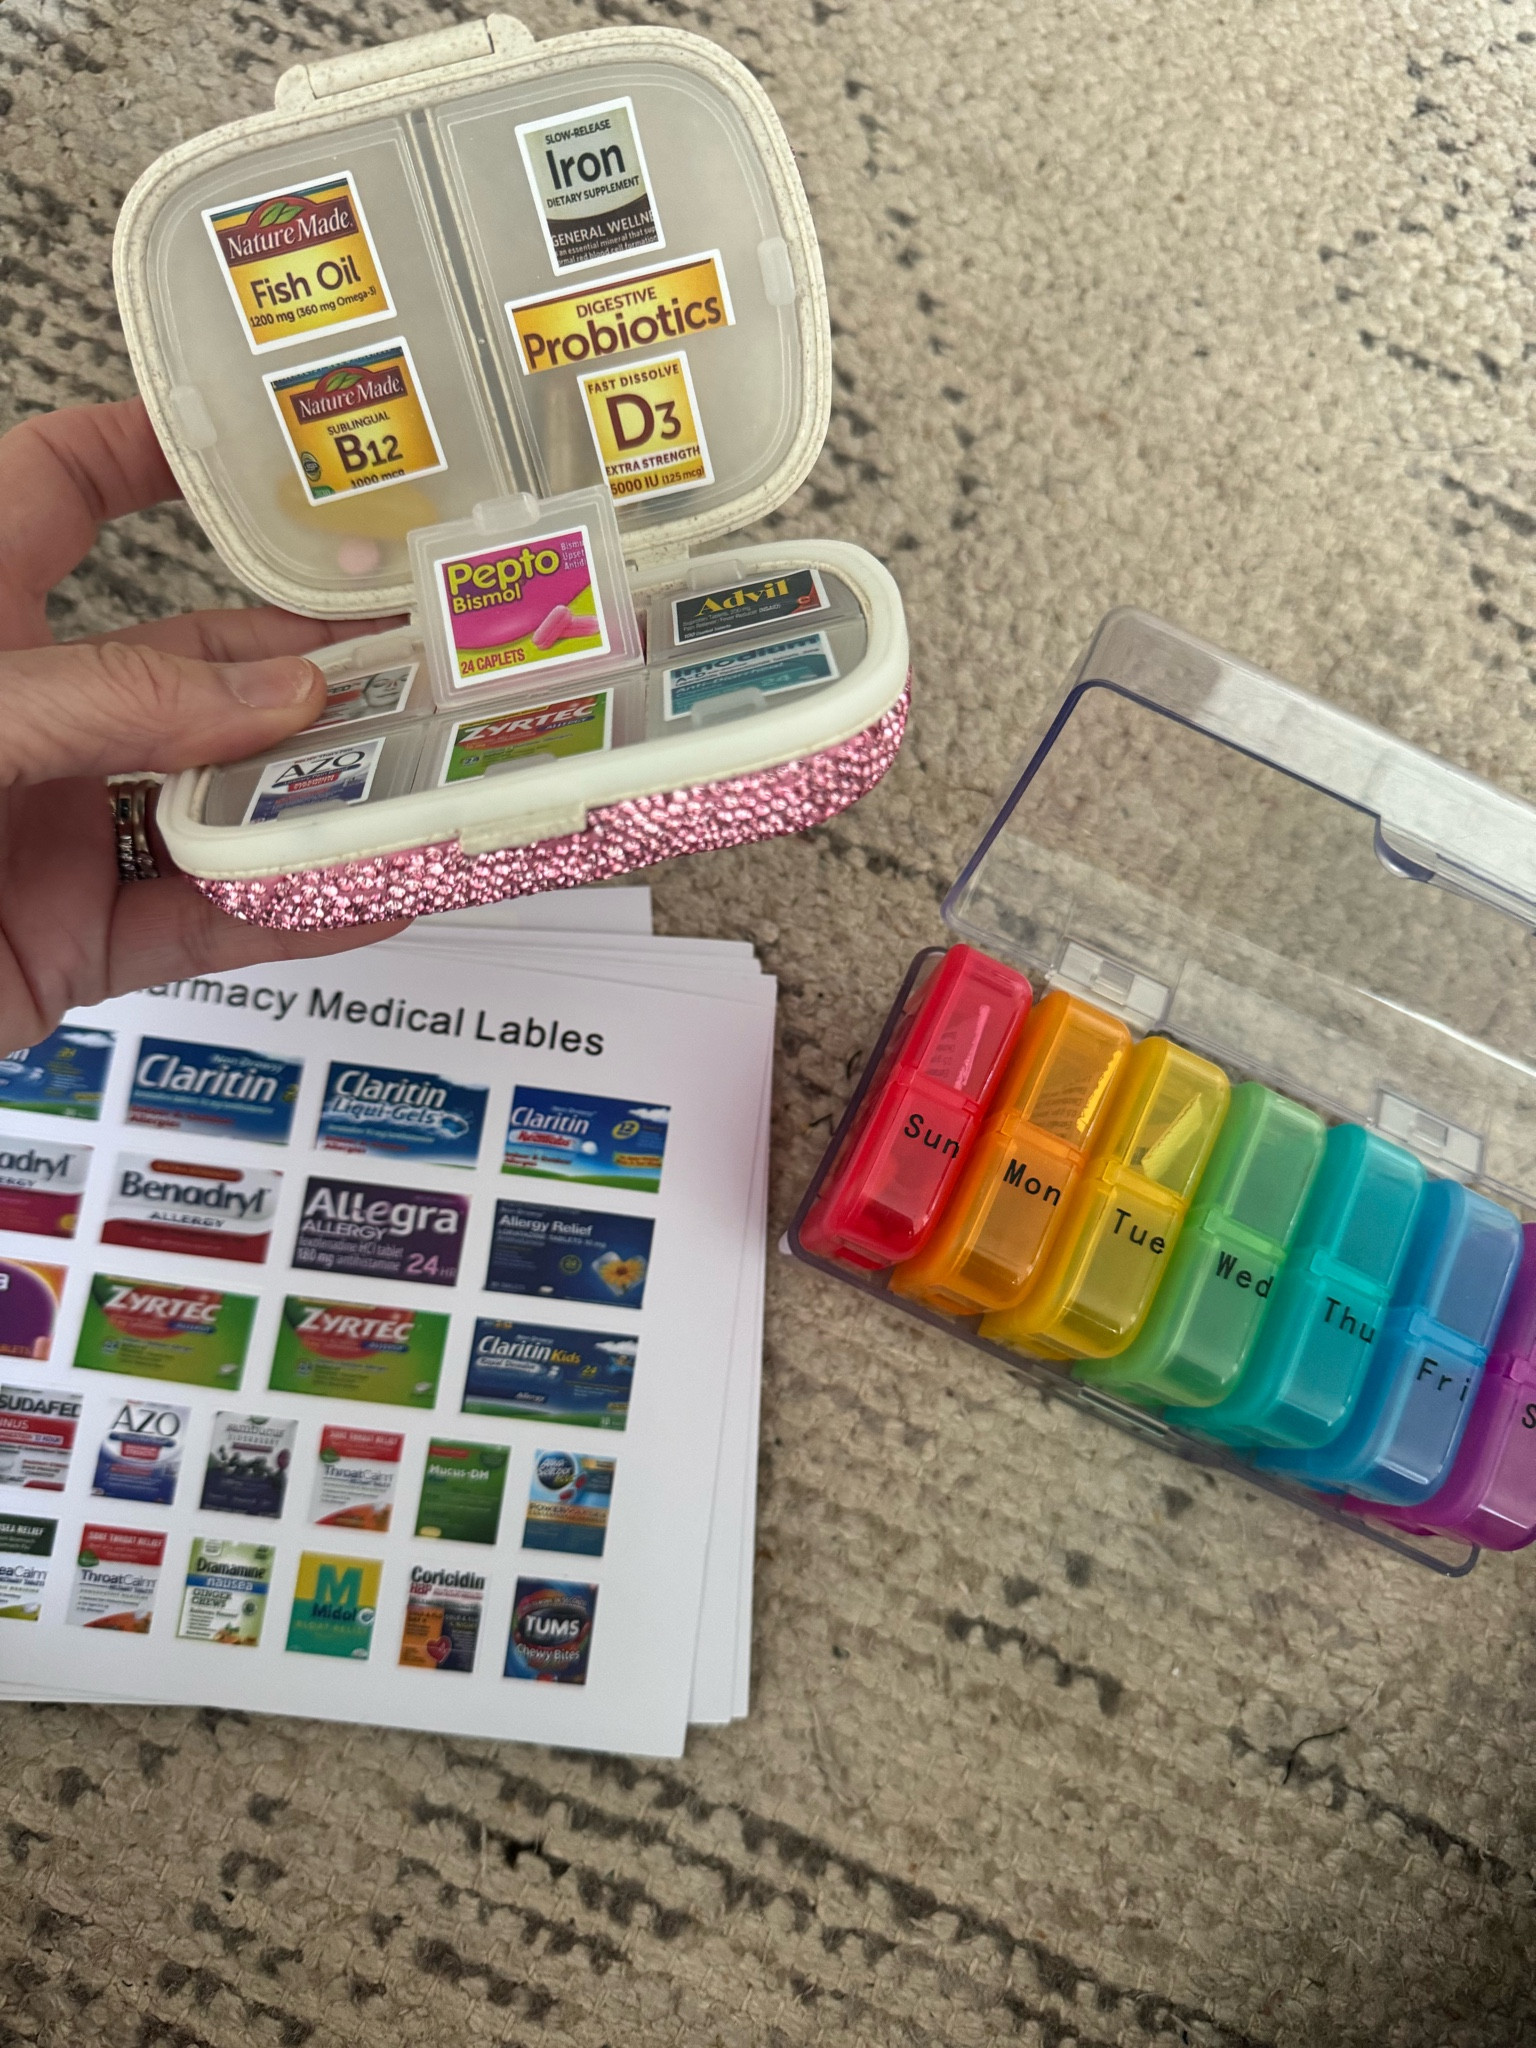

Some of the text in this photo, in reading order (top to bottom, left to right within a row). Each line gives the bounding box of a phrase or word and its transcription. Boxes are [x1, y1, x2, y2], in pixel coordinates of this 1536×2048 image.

[545, 119, 611, 145] SLOW-RELEASE
[545, 144, 626, 190] Iron
[546, 175, 640, 209] DIETARY SUPPLEMENT
[227, 207, 351, 259] Nature Made
[552, 224, 606, 247] GENERAL
[250, 255, 361, 309] Fish Oil
[250, 286, 376, 328] 1200 mg (360 mg Omega-3)
[576, 286, 658, 318] DIGESTIVE
[522, 296, 722, 369] Probiotics
[587, 363, 680, 395] FAST DISSOLVE
[299, 391, 355, 419] Nature
[606, 393, 681, 451] D3
[327, 410, 390, 436] SUBLINGUAL
[333, 434, 404, 474] B12
[605, 446, 701, 476] EXTRA STRENGTH
[351, 473, 379, 489] 1000
[610, 478, 642, 495] 5000
[644, 474, 659, 489] IU
[447, 548, 560, 596] Pepto
[452, 583, 521, 614] Bismol
[695, 579, 789, 617] Advil
[461, 648, 525, 675] 24 CAPLETS
[458, 703, 597, 743] ZYRTEC
[275, 751, 366, 783] AZO
[306, 987, 464, 1036] Medical
[475, 1009, 605, 1057] Lables
[138, 1053, 279, 1103] Claritin
[335, 1070, 447, 1108] Claritin
[511, 1106, 590, 1135] Claritin
[904, 1113, 960, 1158] Sun
[121, 1168, 265, 1218] Benadryl
[1003, 1158, 1061, 1206] Mon
[150, 1211, 226, 1229] ALLERGY
[305, 1186, 459, 1237] Allegra
[498, 1214, 593, 1236] Allergy Relief
[301, 1219, 389, 1242] ALLERGY
[1113, 1208, 1166, 1255] Tue
[406, 1253, 440, 1277] 24
[1215, 1251, 1275, 1298] Wed
[103, 1285, 223, 1323] ZYRTEC
[1323, 1296, 1376, 1344] Thu
[297, 1306, 415, 1341] ZYRTEC
[478, 1334, 552, 1363] Claritin
[550, 1348, 581, 1365] Kids
[1417, 1357, 1471, 1401] Fri
[111, 1404, 181, 1437] AZO
[196, 1556, 266, 1579] Dramamine
[206, 1577, 254, 1591] nausea
[314, 1563, 364, 1605] M
[411, 1565, 485, 1590] Coricidin
[526, 1615, 580, 1636] TUMS
[516, 1643, 552, 1661] Chewy
